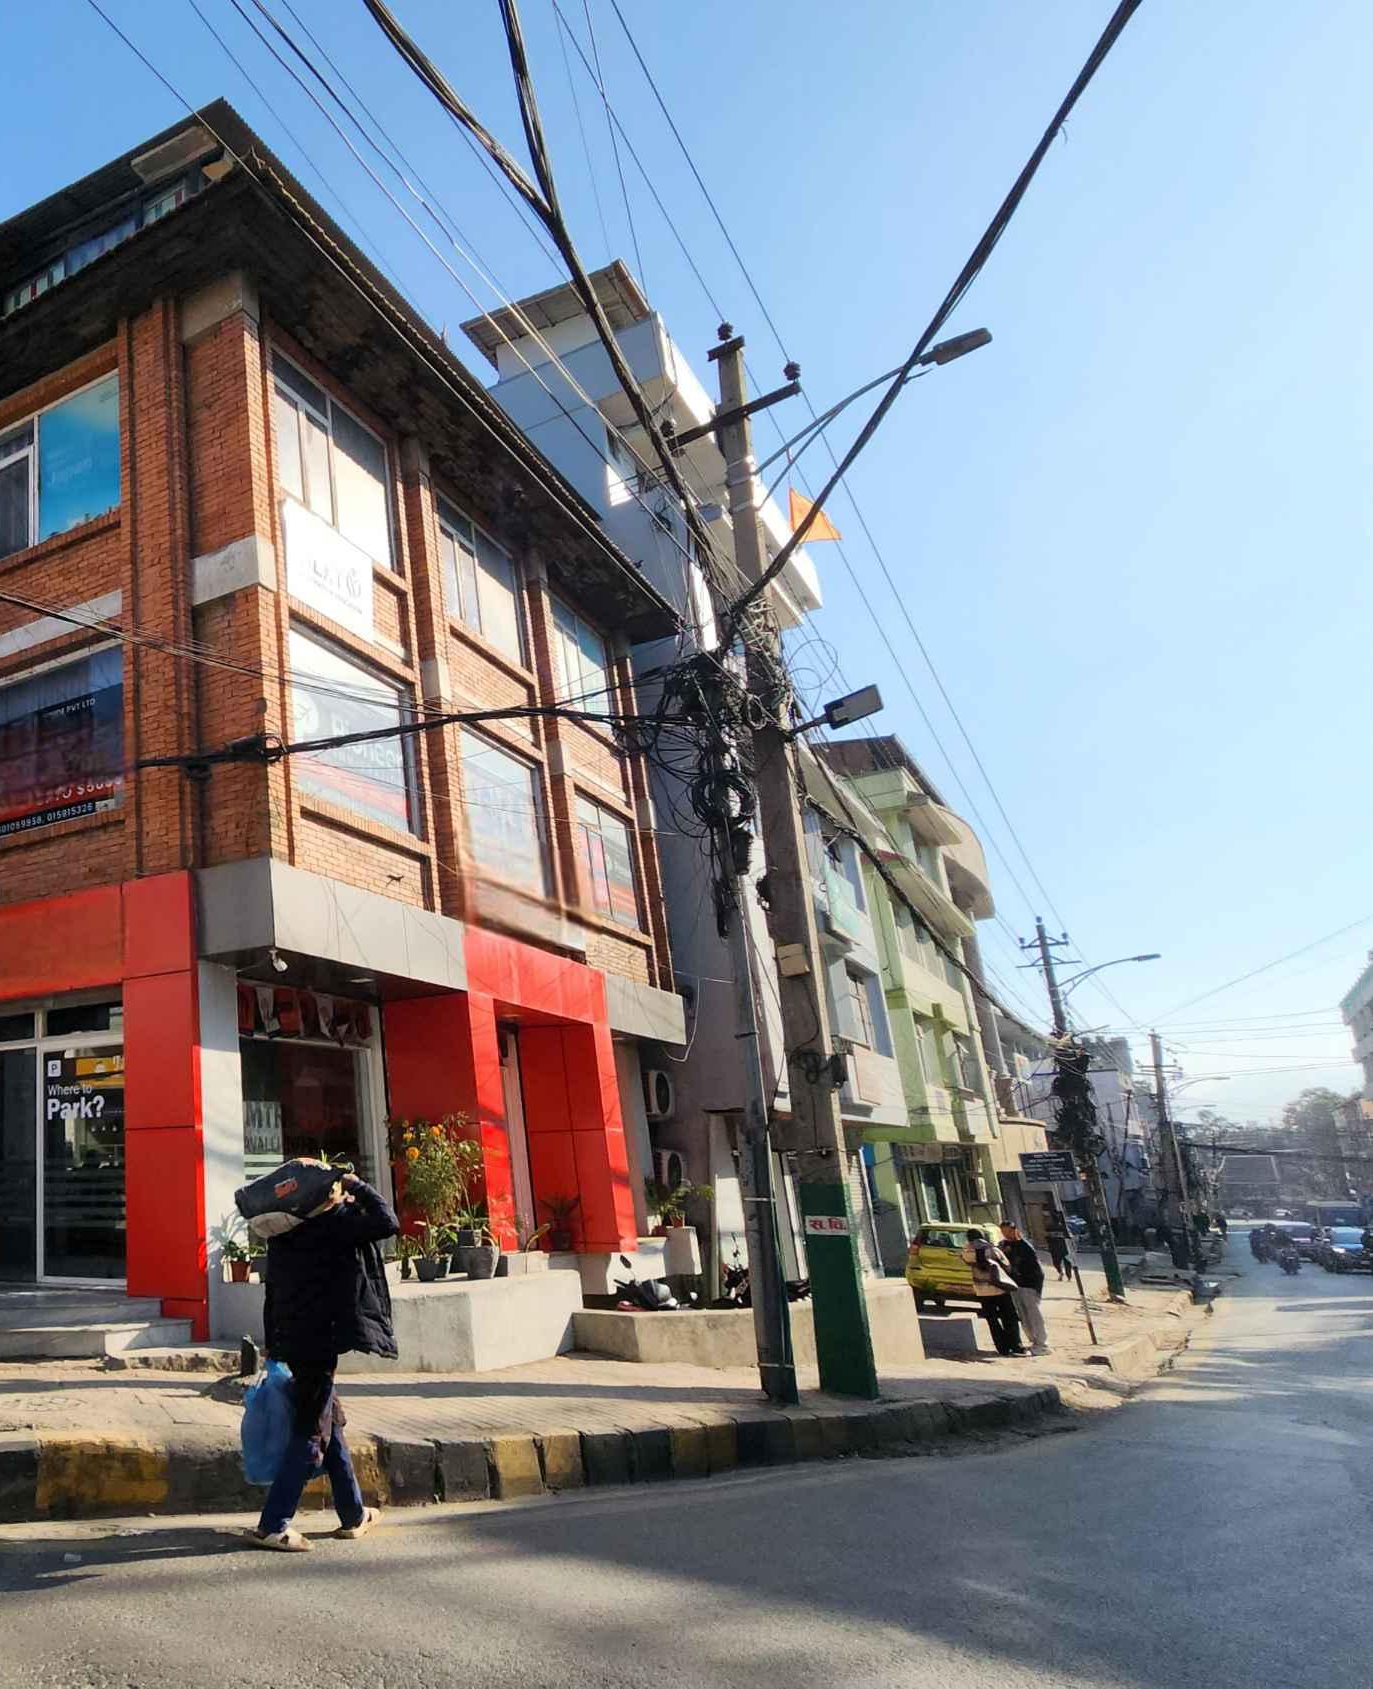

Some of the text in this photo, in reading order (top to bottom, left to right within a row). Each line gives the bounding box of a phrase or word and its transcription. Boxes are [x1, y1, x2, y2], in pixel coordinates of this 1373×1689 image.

[47, 1084, 93, 1096] Where to
[47, 1095, 105, 1120] Park?
